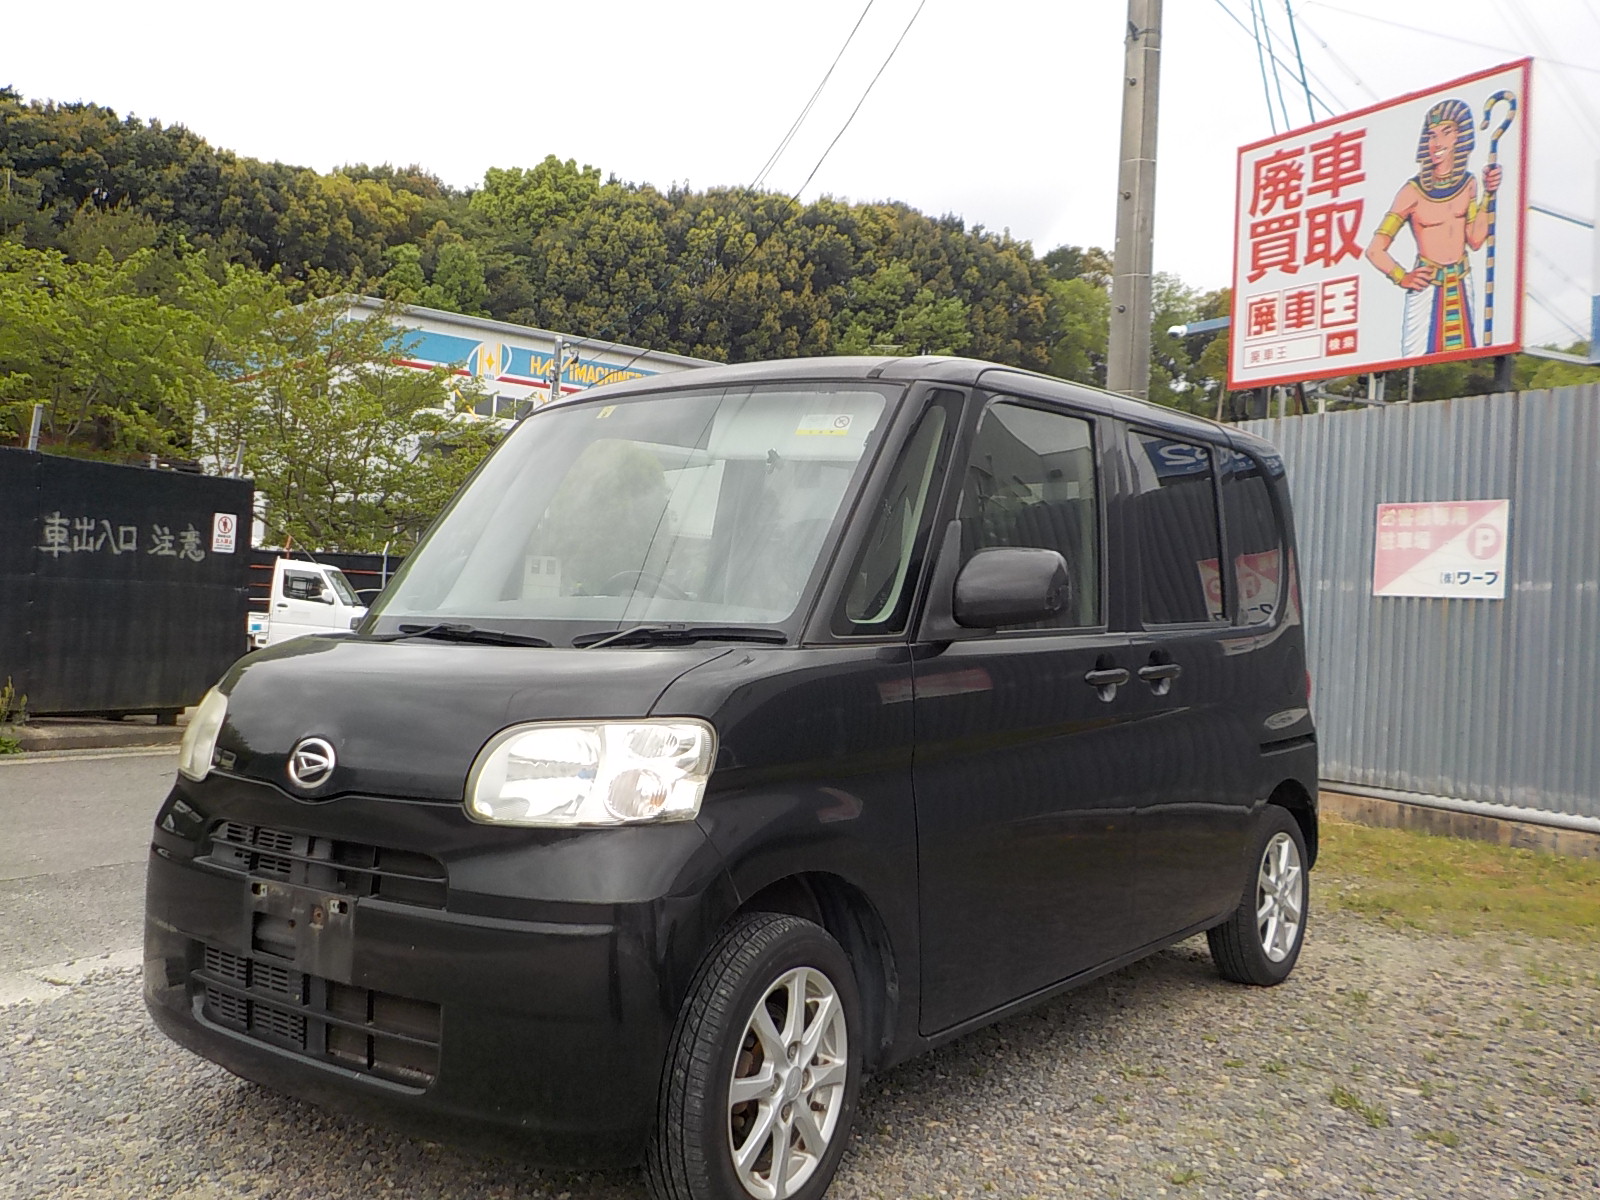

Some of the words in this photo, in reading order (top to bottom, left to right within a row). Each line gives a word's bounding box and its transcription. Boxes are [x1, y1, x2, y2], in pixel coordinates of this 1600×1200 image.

[1248, 127, 1368, 218] 廃車
[1246, 198, 1366, 284] 買取
[1247, 274, 1359, 337] 廃車王
[38, 510, 137, 559] 車出入口
[147, 522, 206, 563] 注意
[1475, 528, 1497, 556] P
